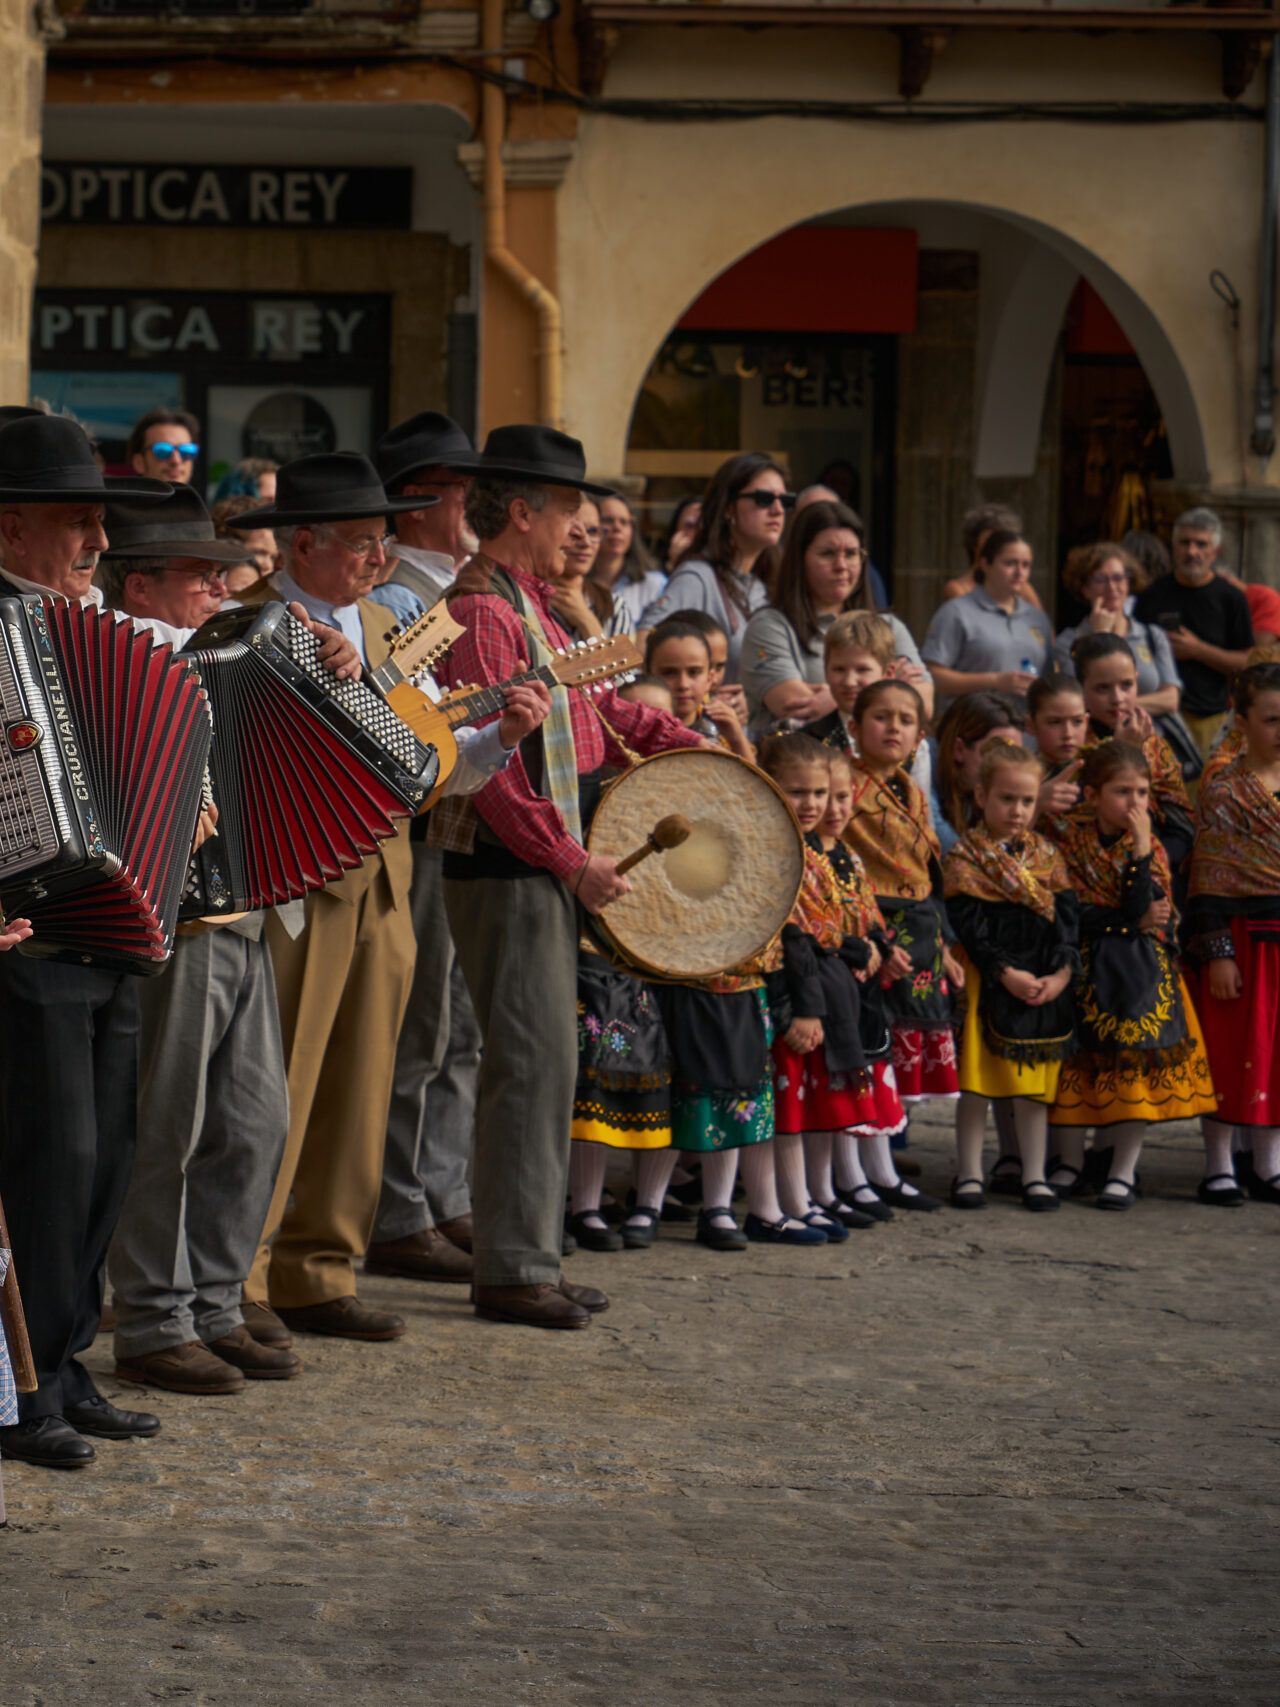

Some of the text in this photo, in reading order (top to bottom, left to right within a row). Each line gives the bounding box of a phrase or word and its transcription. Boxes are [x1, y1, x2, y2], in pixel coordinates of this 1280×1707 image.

[249, 172, 348, 223] REY
[31, 305, 365, 353] PTICA REY
[42, 656, 89, 801] CRUCIANELLI
